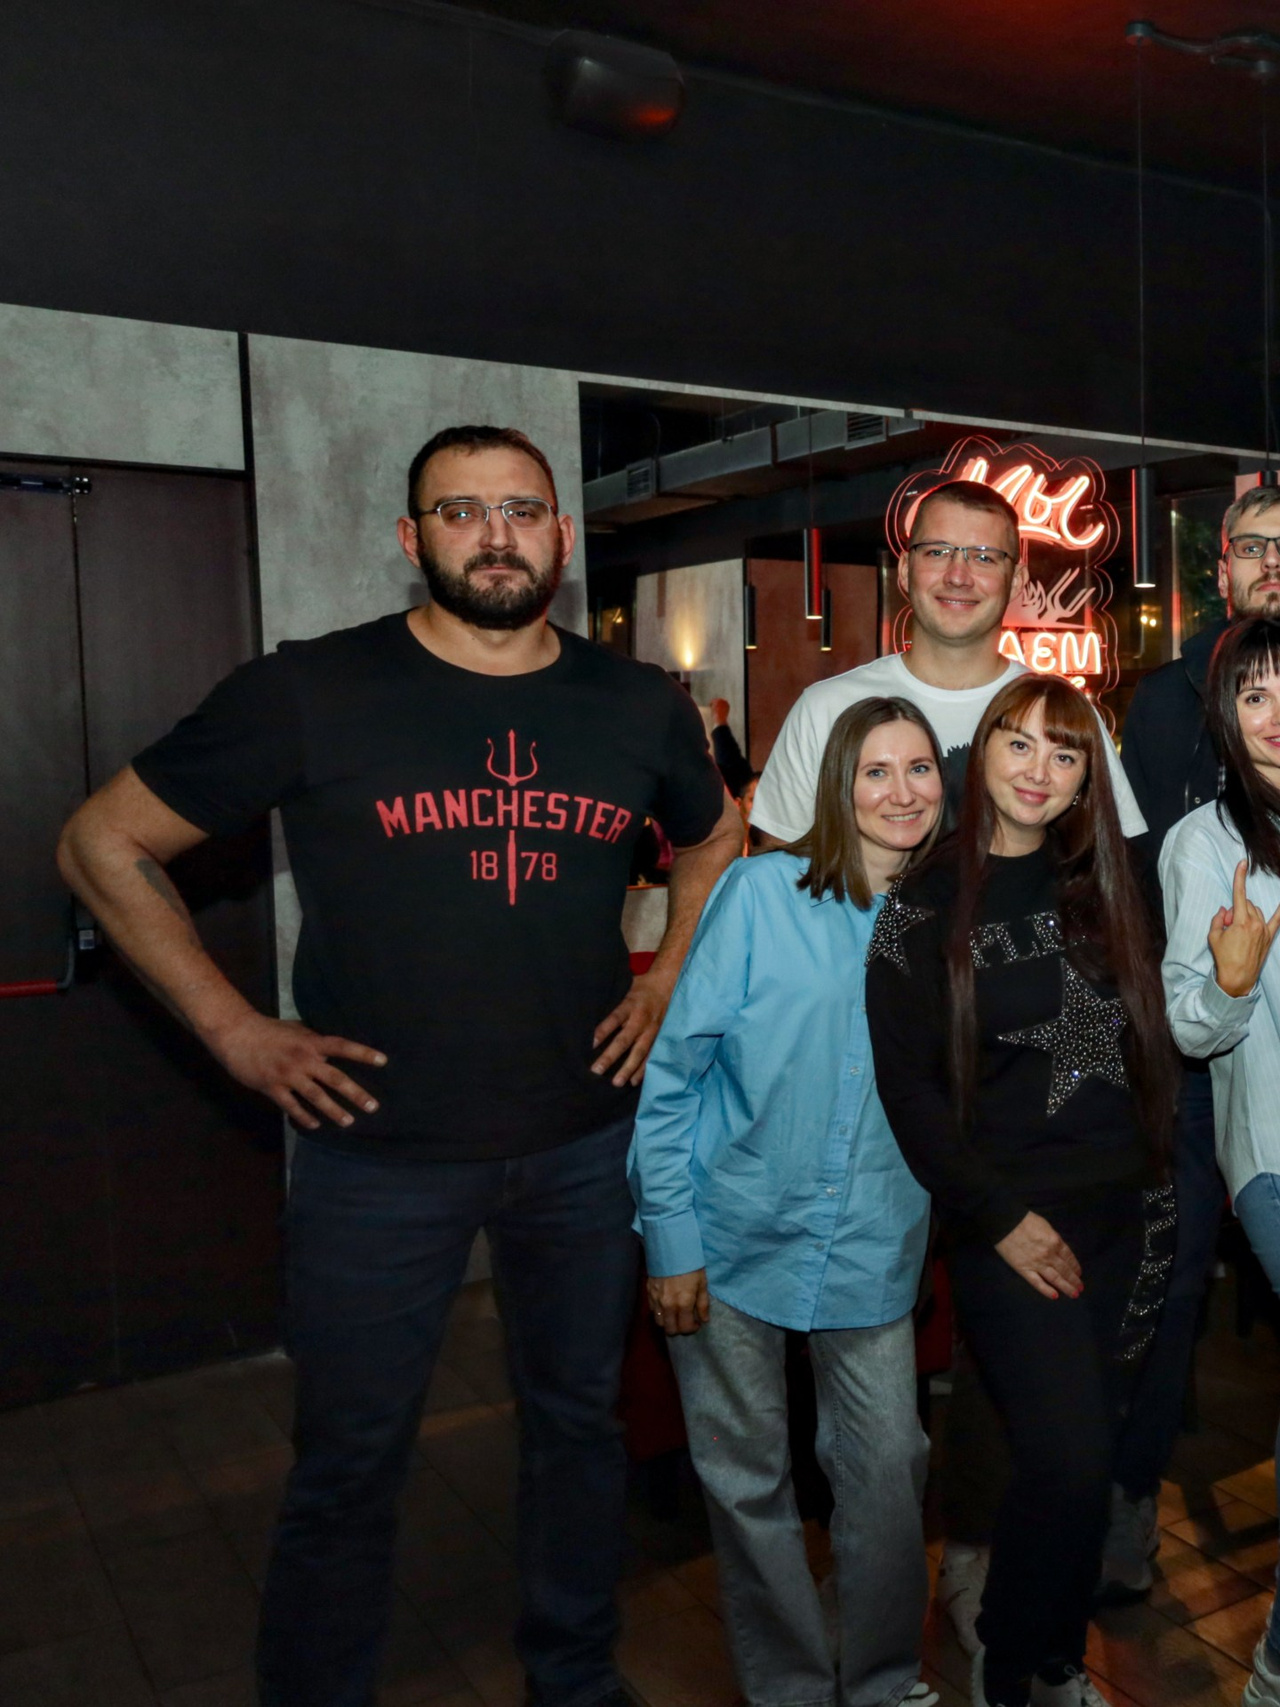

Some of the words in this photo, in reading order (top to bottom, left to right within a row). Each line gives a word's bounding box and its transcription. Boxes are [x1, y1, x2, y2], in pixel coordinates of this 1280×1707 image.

[375, 789, 632, 843] MANCHESTER
[470, 850, 498, 880] 18
[521, 852, 557, 881] 78
